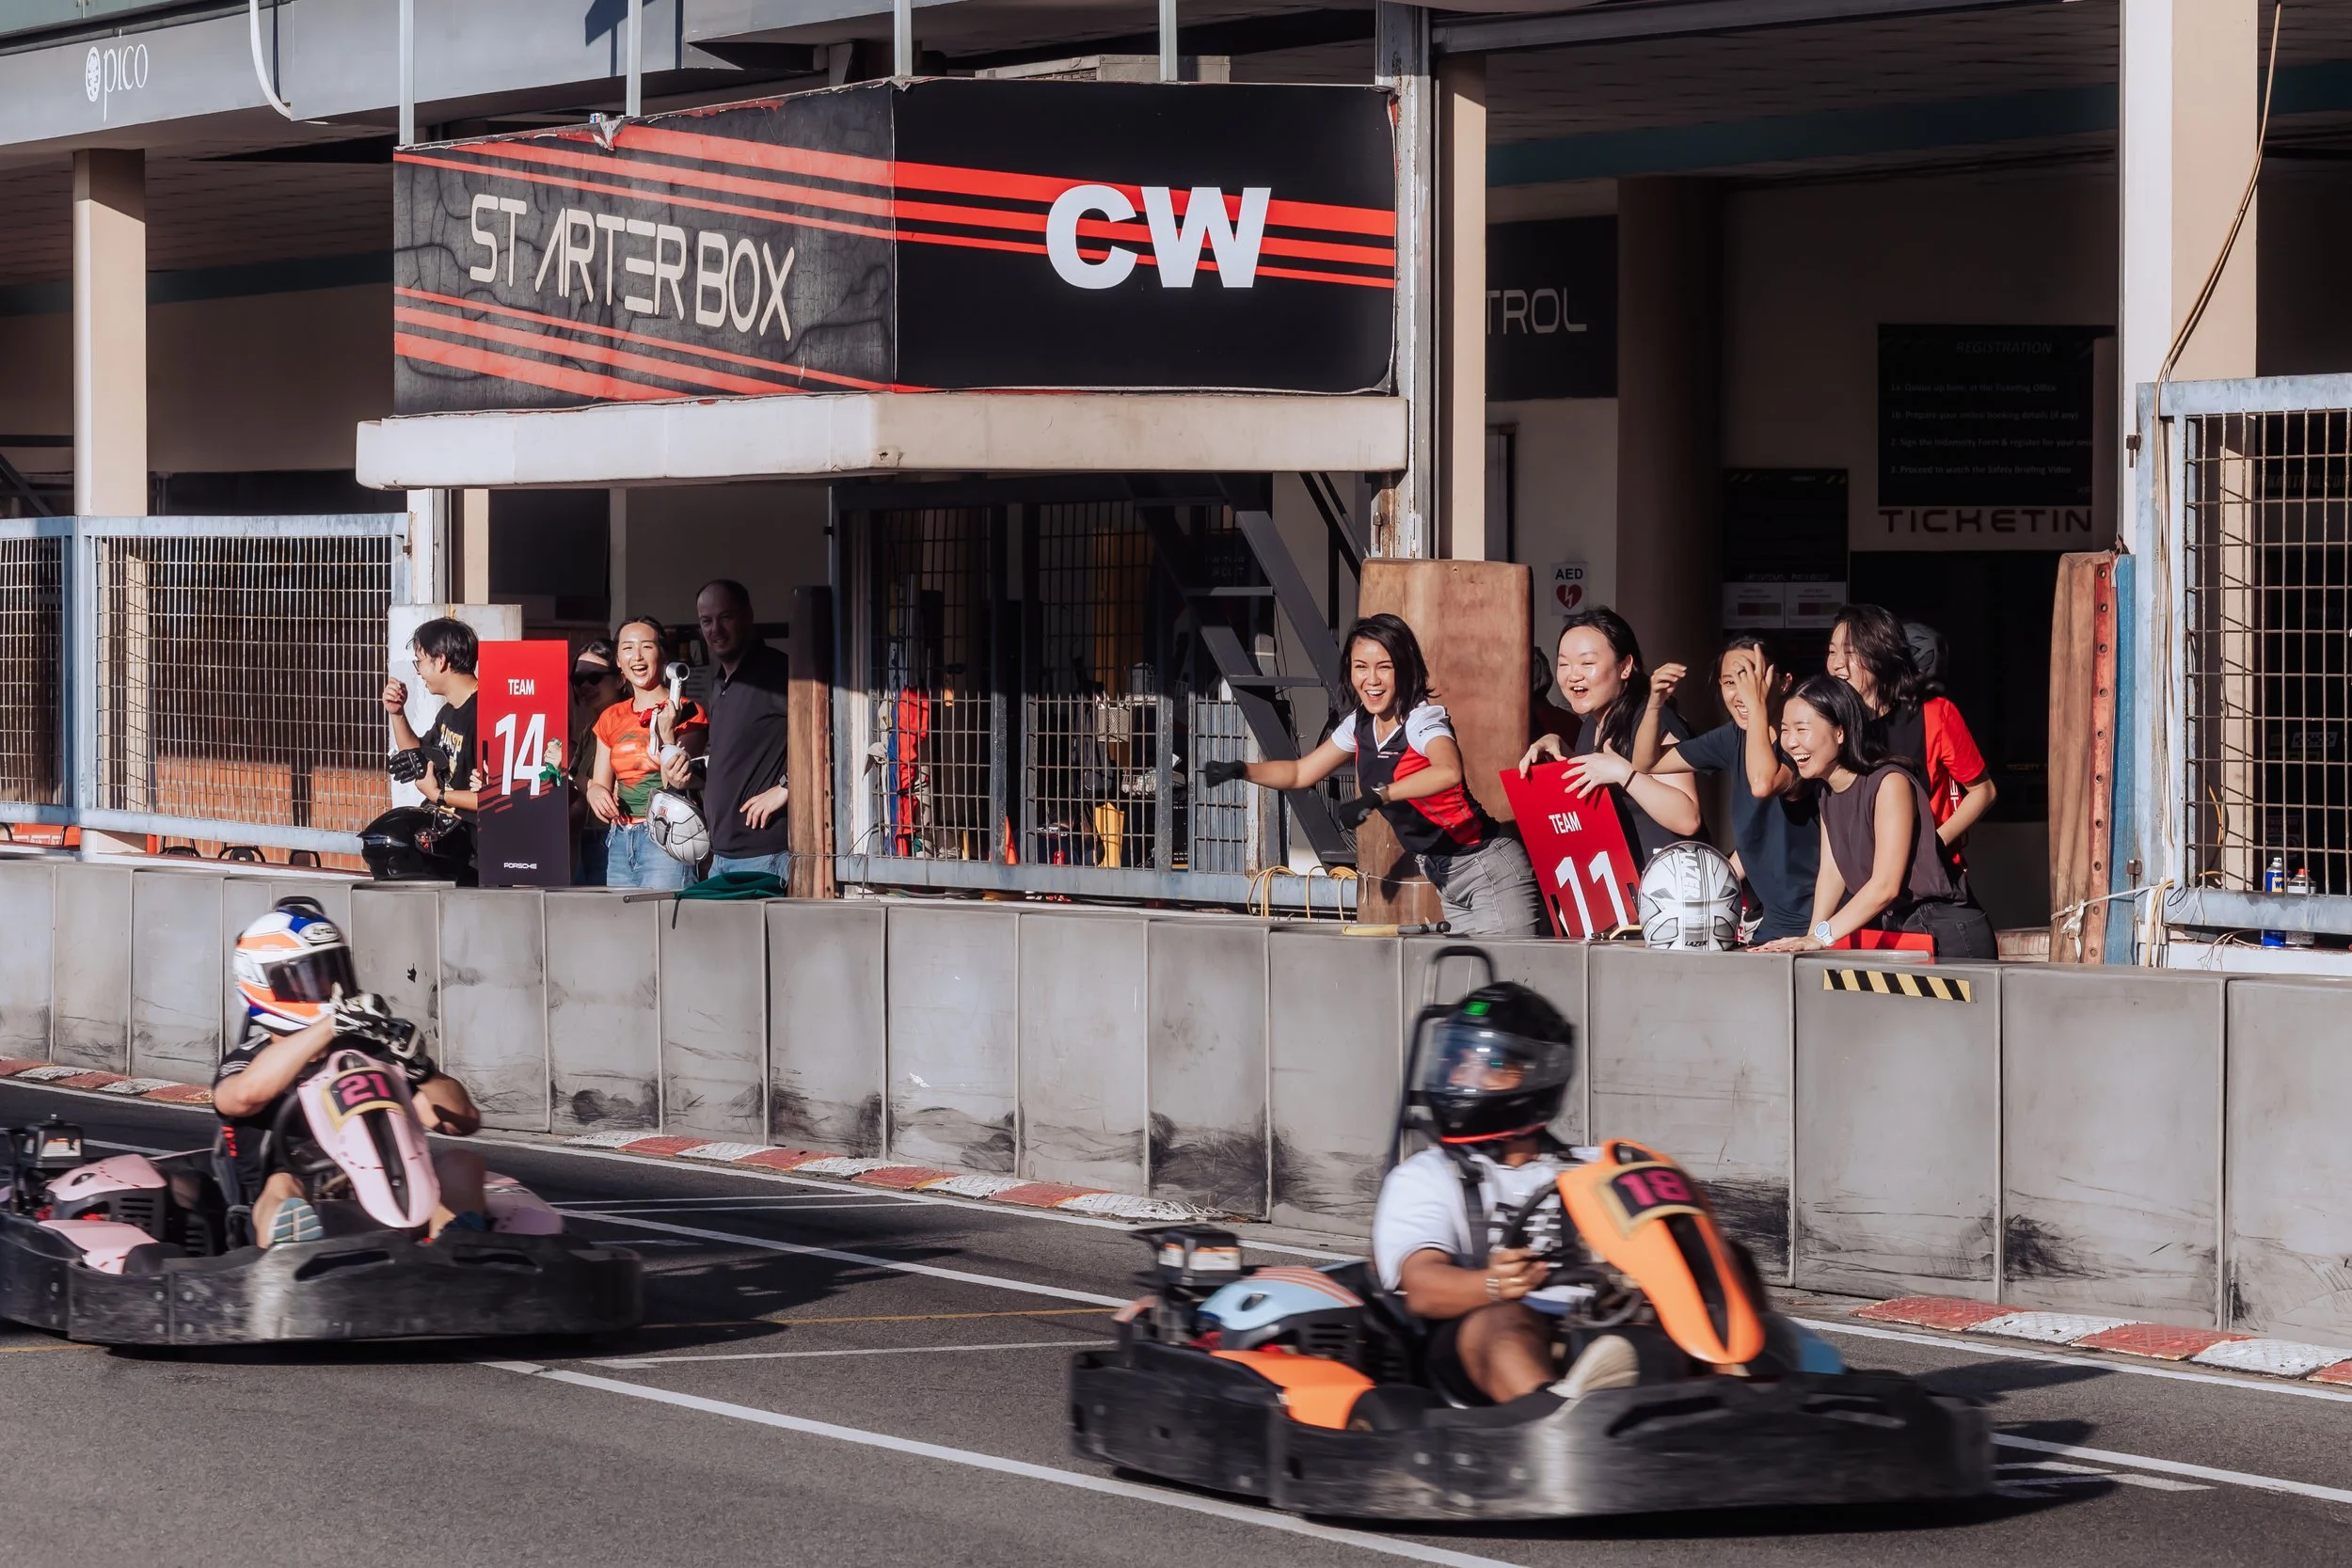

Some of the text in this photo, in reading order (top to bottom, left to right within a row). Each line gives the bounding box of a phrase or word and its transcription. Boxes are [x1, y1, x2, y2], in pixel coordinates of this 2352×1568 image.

[103, 28, 149, 123] pico
[1046, 184, 1271, 289] CW
[469, 194, 795, 341] STARTER BOX
[1956, 341, 2053, 354] REGISTRATION
[1878, 509, 2092, 533] TICKETIN
[1555, 568, 1583, 579] AED
[508, 679, 534, 695] TEAM
[495, 713, 547, 796] 14
[1549, 811, 1582, 834] TEAM
[1555, 850, 1629, 941] 11
[337, 1073, 391, 1106] 21
[1617, 1169, 1692, 1207] 18
